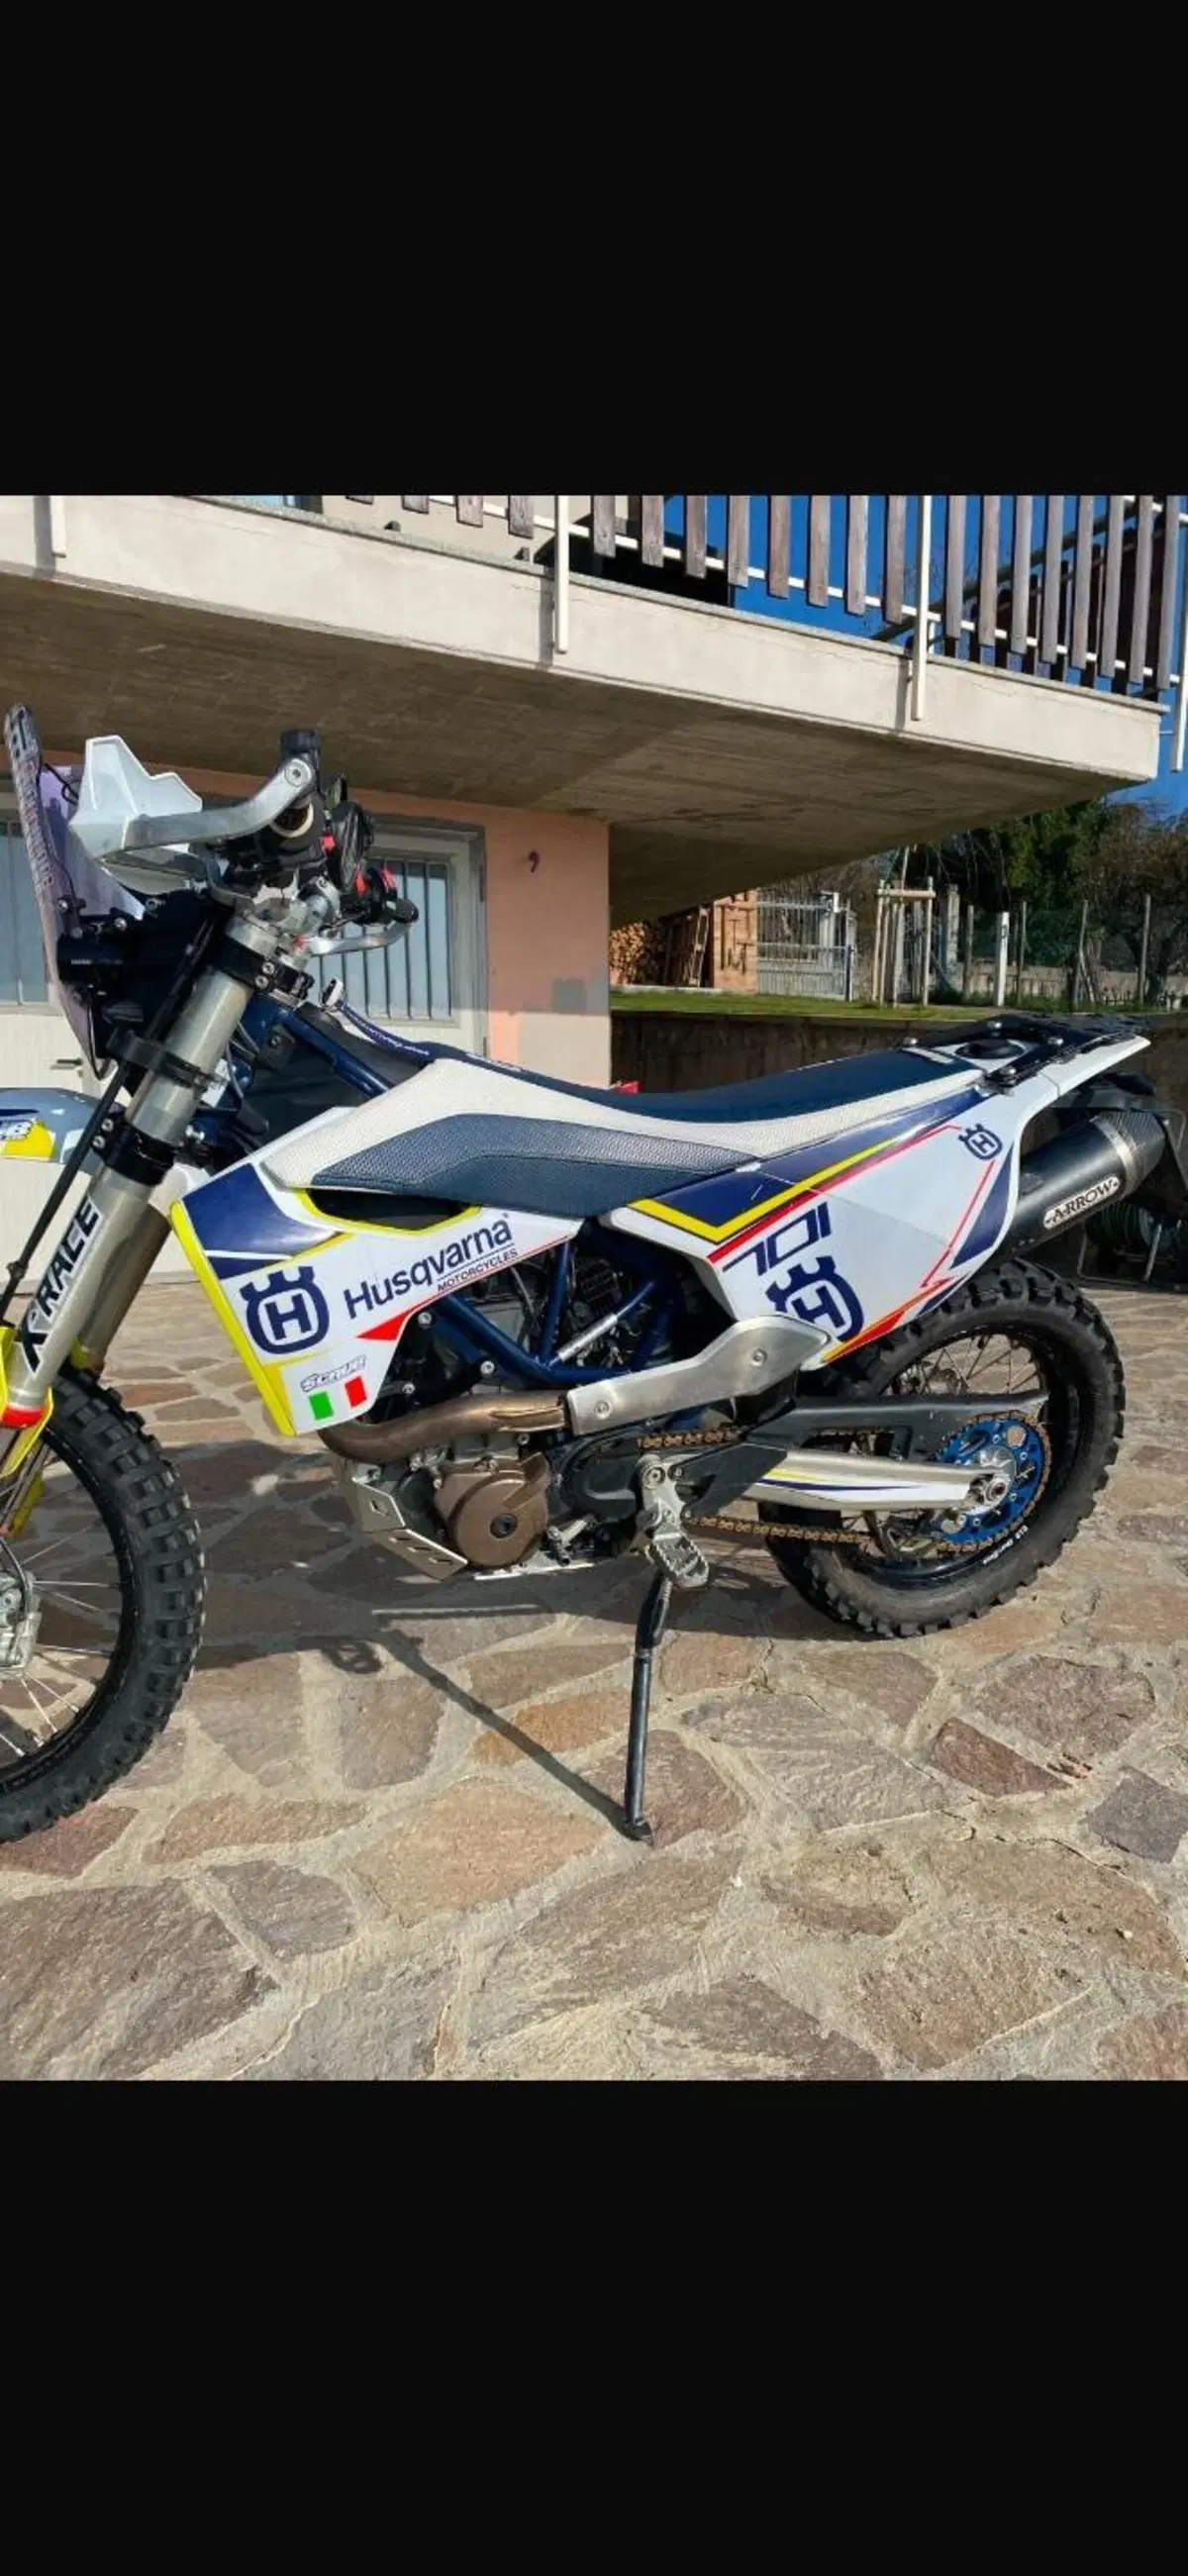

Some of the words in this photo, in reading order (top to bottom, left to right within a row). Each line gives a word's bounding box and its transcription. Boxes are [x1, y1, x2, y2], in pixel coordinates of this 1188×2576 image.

[1050, 1180, 1114, 1223] ARROW
[343, 1219, 513, 1320] Husqvarna
[437, 1247, 518, 1292] MOTORCYCLES
